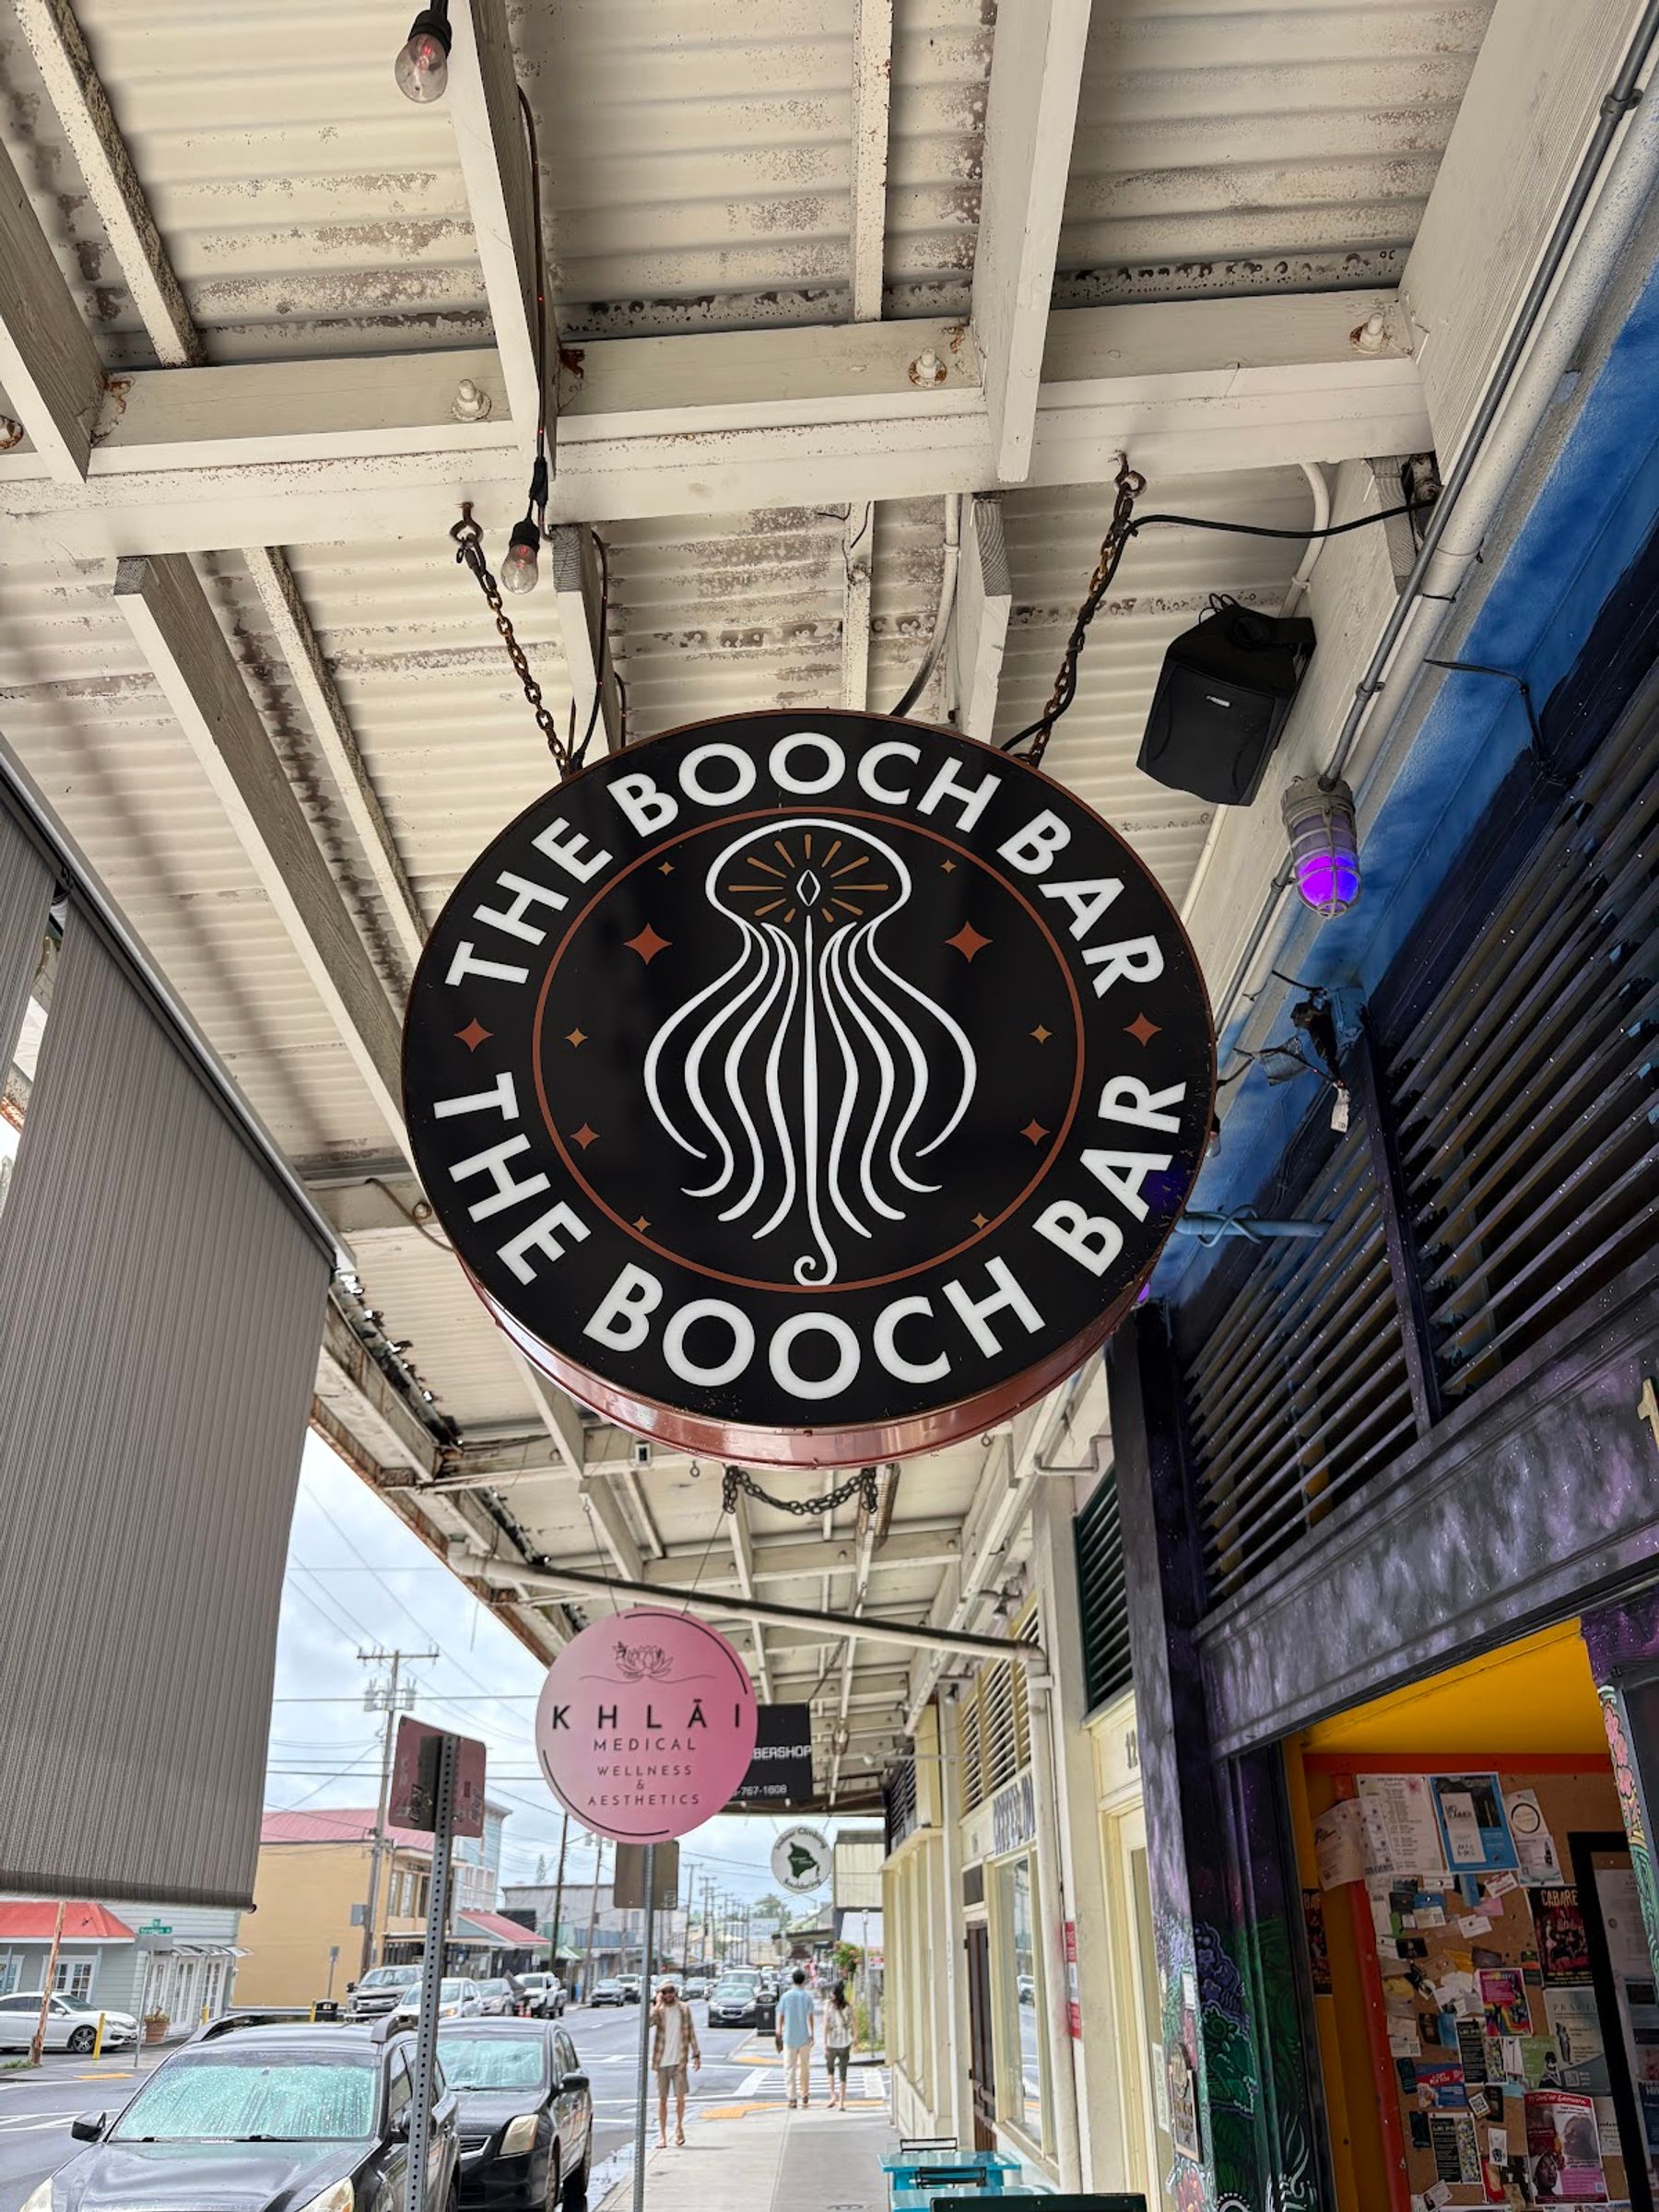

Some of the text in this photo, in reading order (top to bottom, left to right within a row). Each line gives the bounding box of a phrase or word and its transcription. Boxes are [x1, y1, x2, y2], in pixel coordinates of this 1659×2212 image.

[445, 732, 1164, 998] THE BOOCH BAR
[433, 1071, 1186, 1400] THE BOOCH BAR
[594, 1737, 697, 1751] MEDICAL
[753, 1745, 812, 1759] BERSHOP
[597, 1764, 692, 1776] WELLNESS
[636, 1779, 644, 1790] &
[587, 1794, 700, 1806] AESTHETICS
[1541, 1889, 1579, 1907] CABARE
